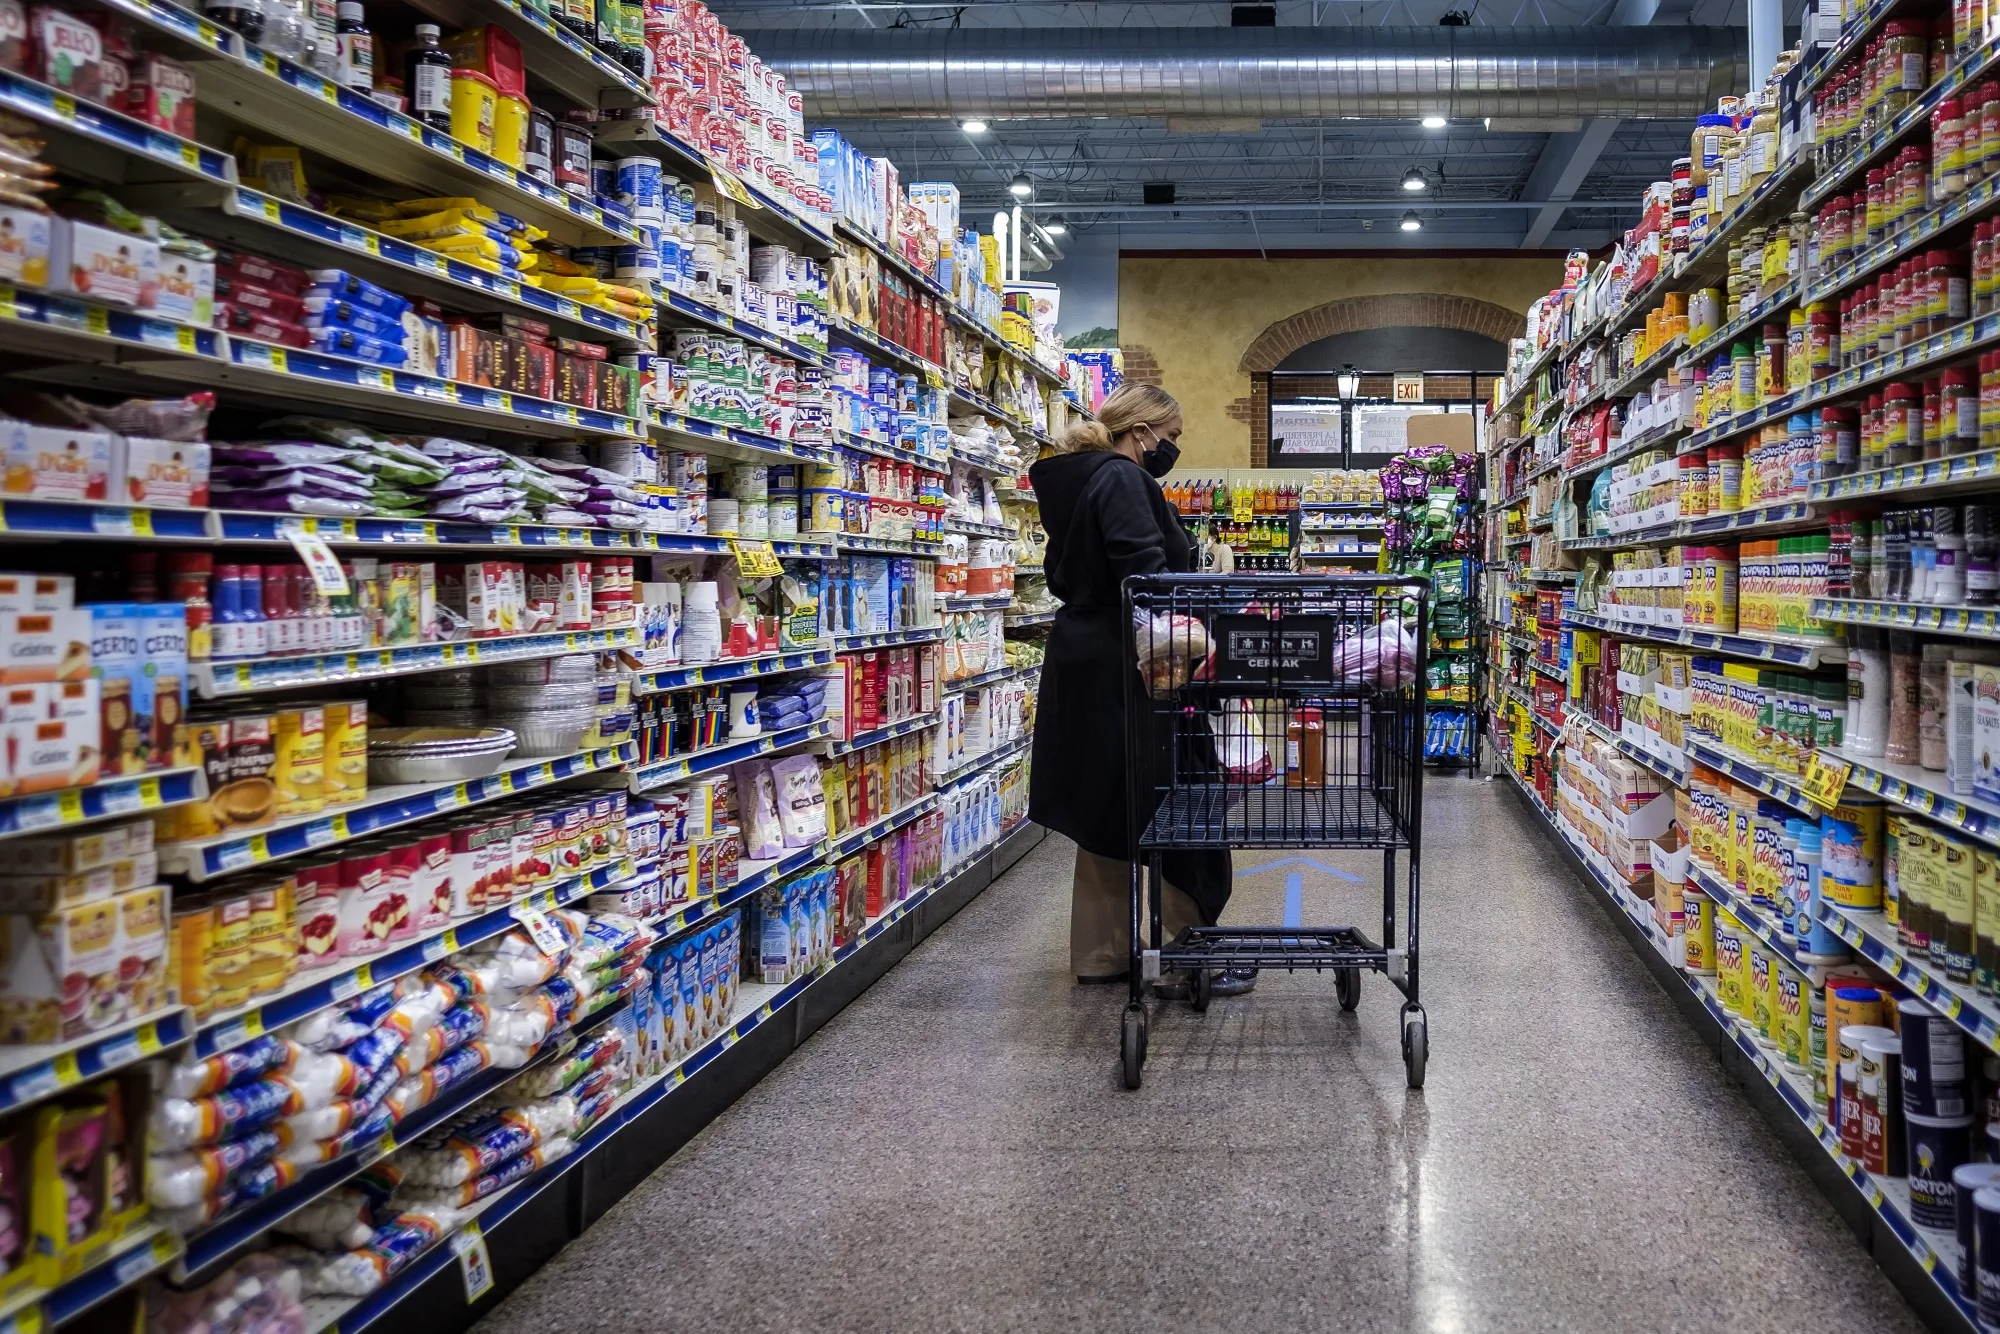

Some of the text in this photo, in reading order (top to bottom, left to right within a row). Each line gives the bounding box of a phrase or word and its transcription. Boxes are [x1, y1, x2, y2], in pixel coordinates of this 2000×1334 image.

[1397, 383, 1420, 399] EXIT
[91, 635, 139, 658] CERTO
[144, 634, 188, 657] CERTO
[706, 704, 728, 713] SUCCESS
[1841, 1097, 1860, 1121] HER
[1862, 1111, 1881, 1138] HER
